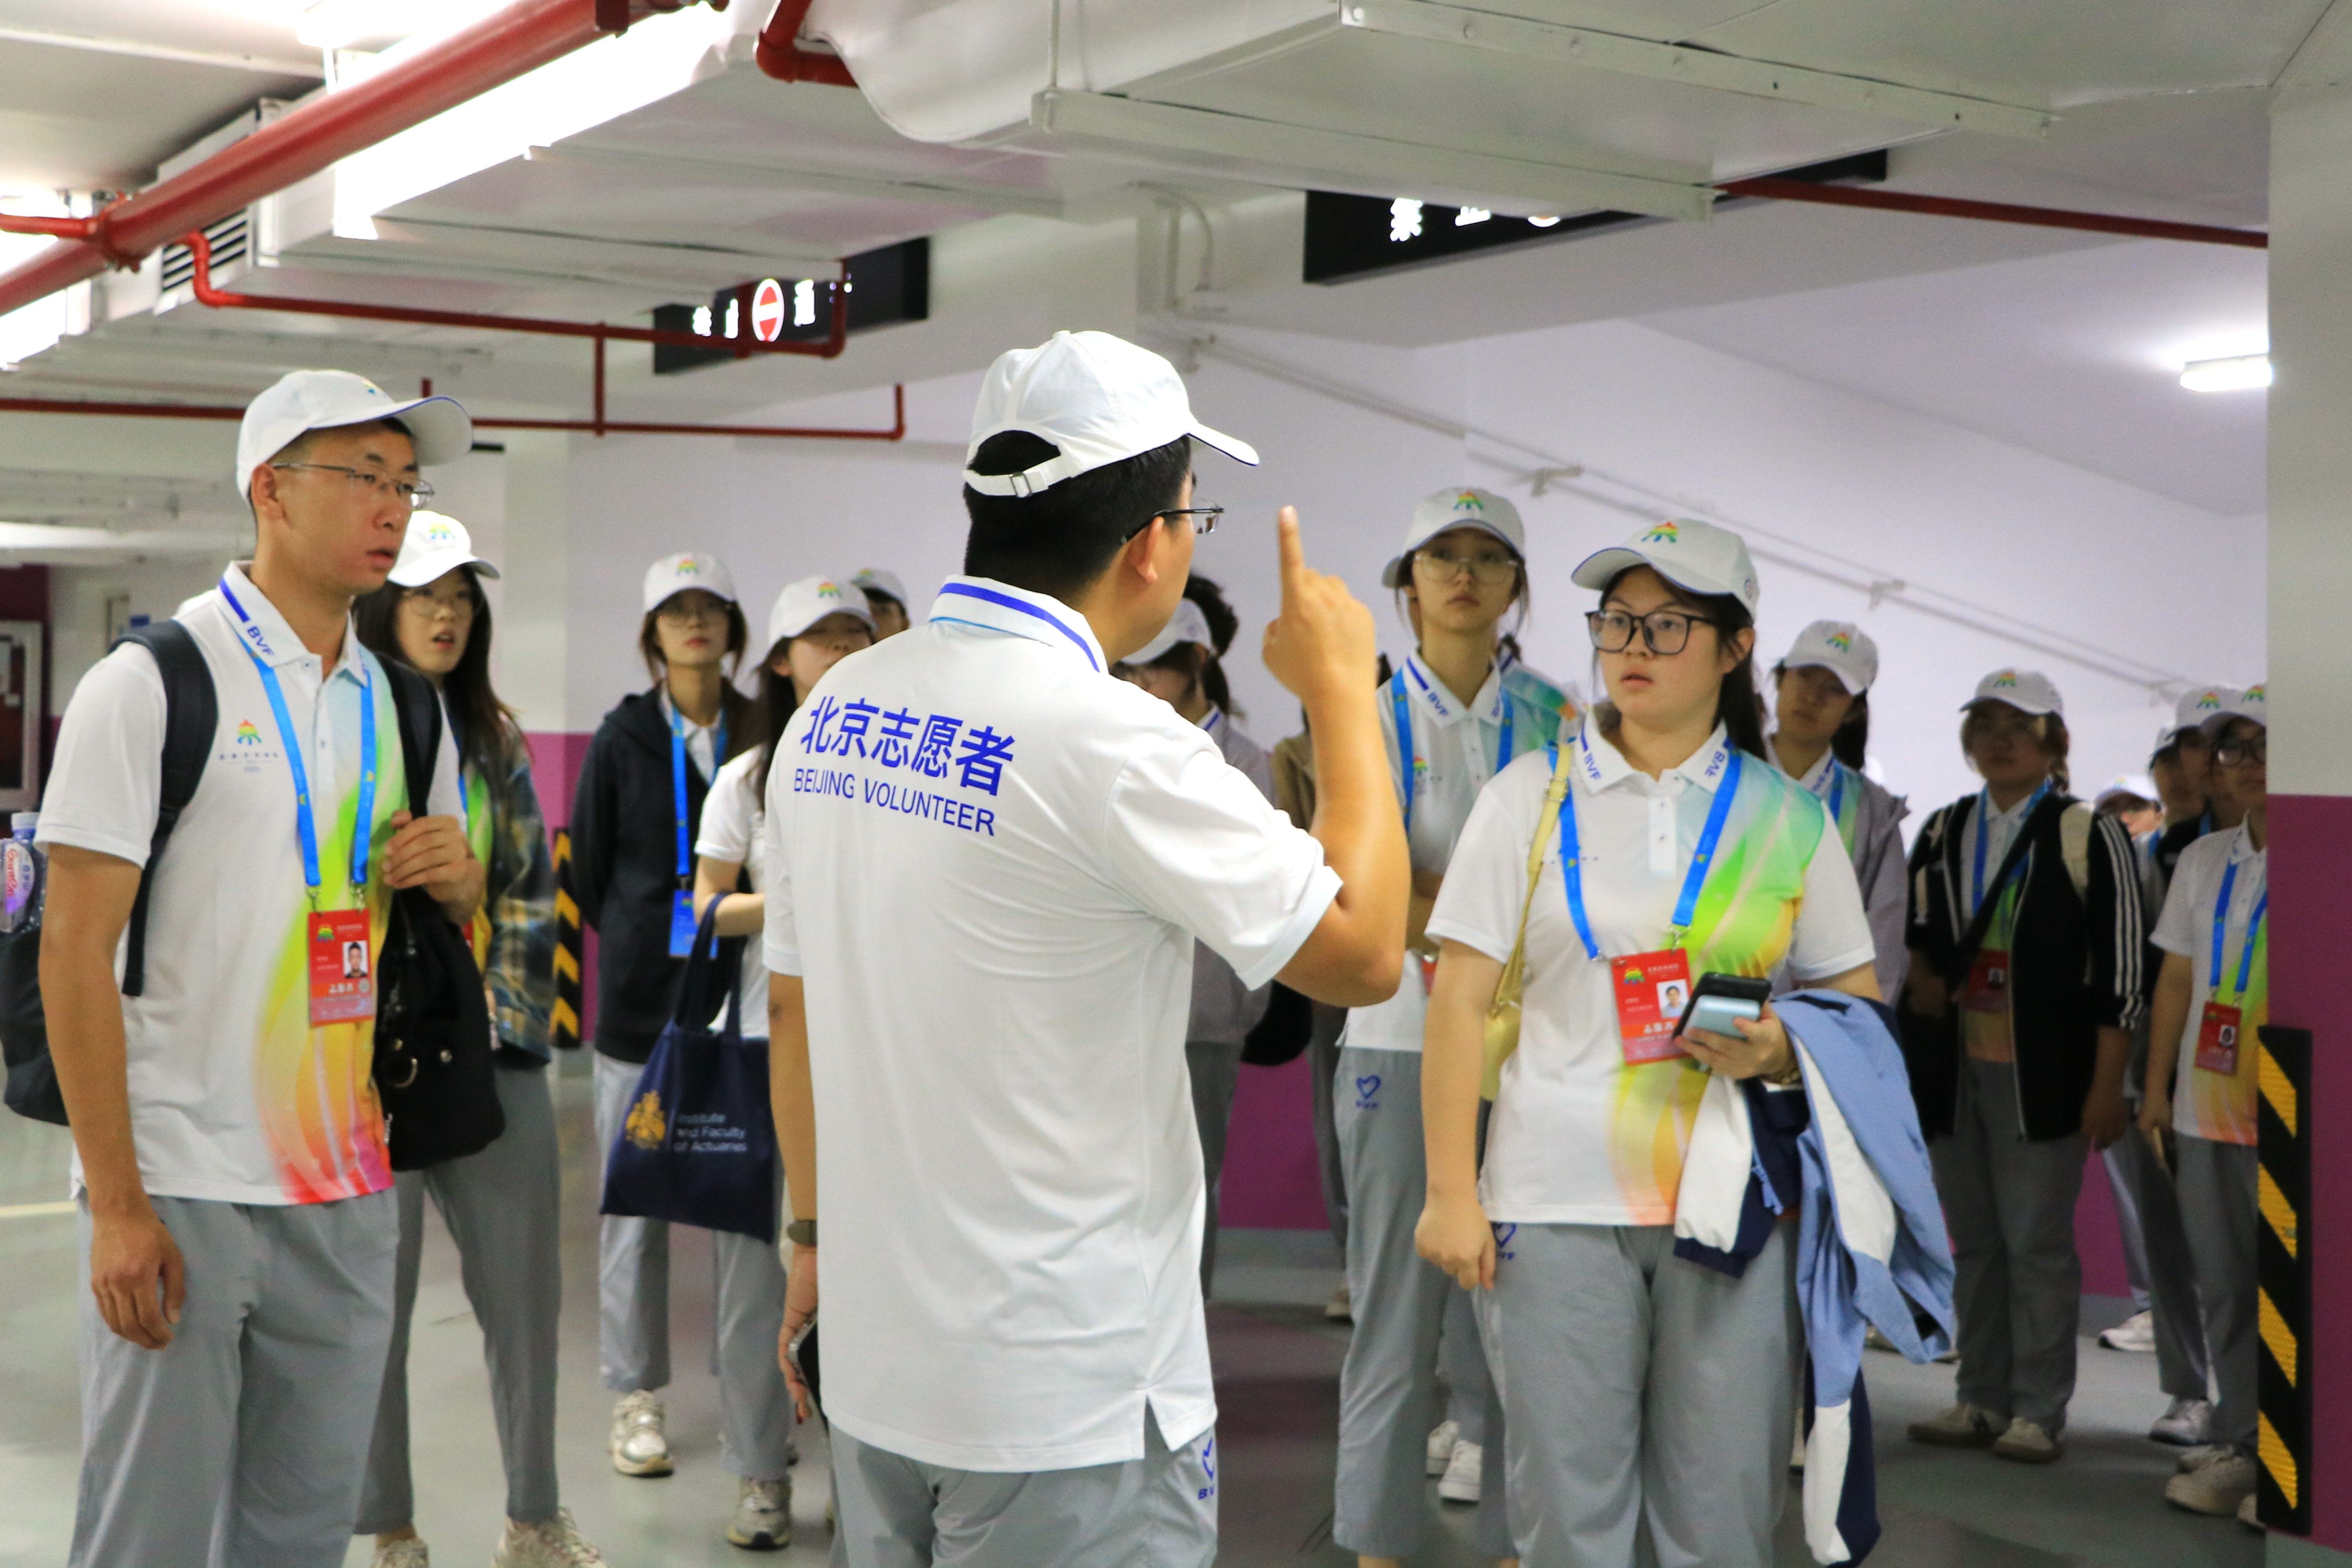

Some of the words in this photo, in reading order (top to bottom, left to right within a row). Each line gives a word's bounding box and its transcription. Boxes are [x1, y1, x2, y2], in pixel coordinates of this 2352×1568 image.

[247, 626, 274, 655] BVF
[1428, 692, 1449, 716] BVF
[800, 696, 1015, 796] 北京志愿者
[1584, 753, 1601, 779] BVF
[1704, 751, 1725, 777] BVF
[793, 768, 855, 799] BEIJING
[864, 778, 995, 836] VOLUNTEER
